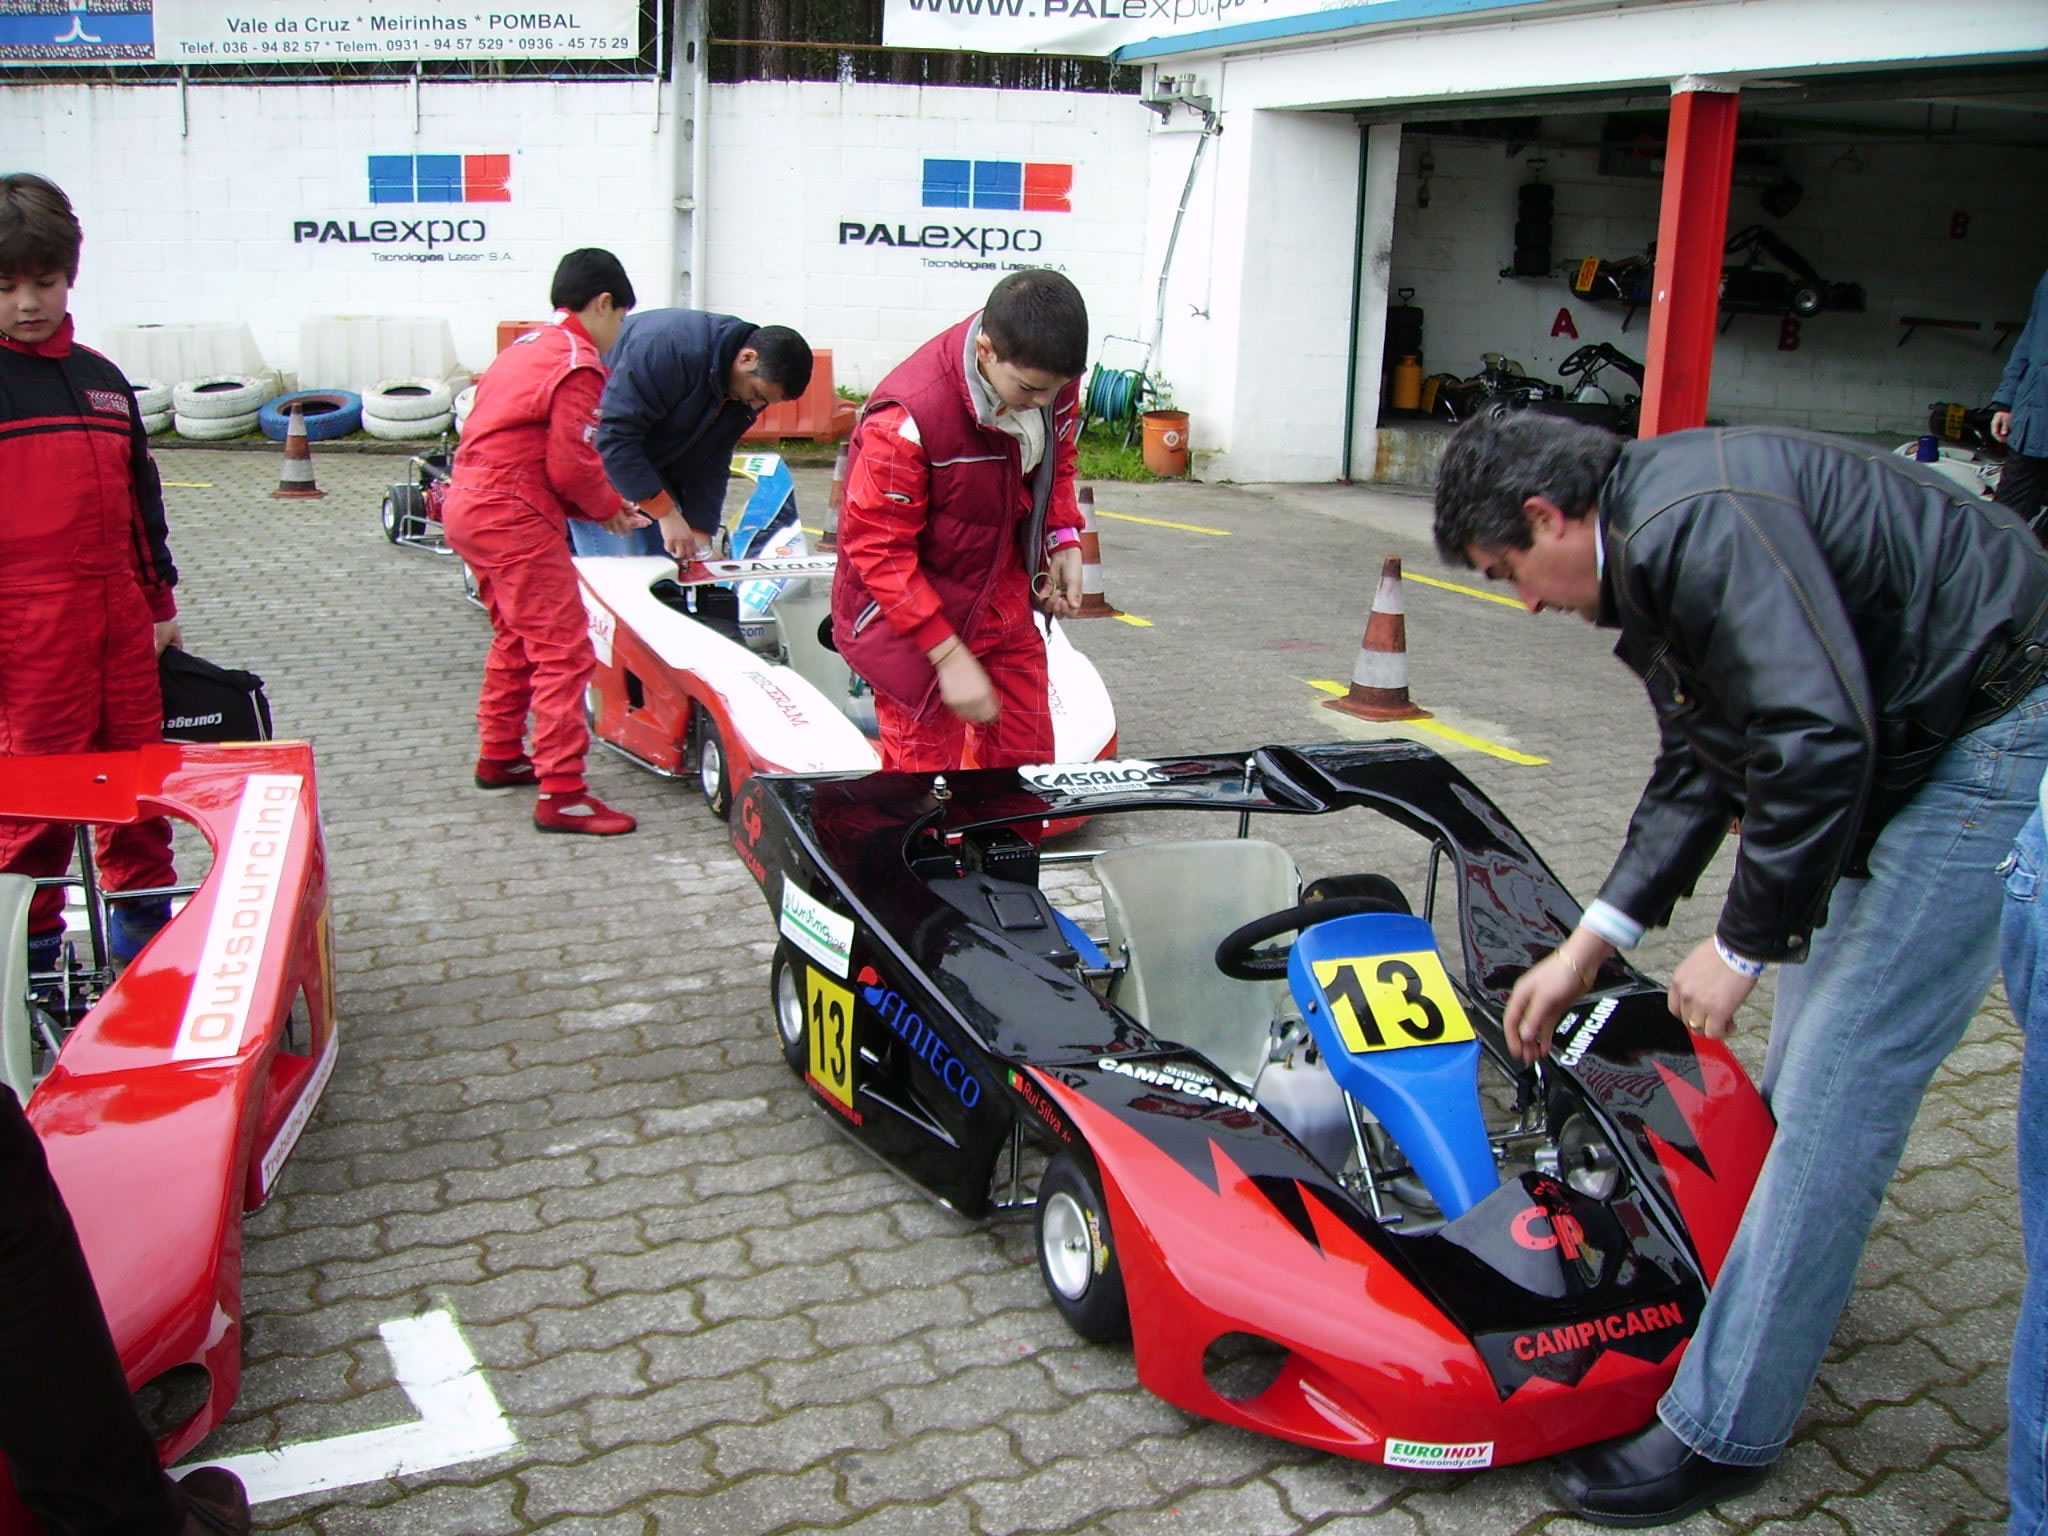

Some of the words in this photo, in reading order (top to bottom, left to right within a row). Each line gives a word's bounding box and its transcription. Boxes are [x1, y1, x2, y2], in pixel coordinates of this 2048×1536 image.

[226, 17, 268, 33] Vale
[275, 17, 298, 33] da
[305, 16, 350, 32] Cruz
[371, 15, 468, 32] Meirinhas
[489, 14, 581, 30] POMBAL
[180, 41, 218, 54] Telef.
[223, 42, 248, 53] 036
[262, 42, 279, 53] 94
[283, 42, 300, 52] 82
[304, 41, 320, 52] 57
[335, 41, 381, 52] Telem.
[387, 39, 418, 51] 0931
[434, 39, 451, 50] 94
[456, 39, 472, 49] 57
[478, 38, 503, 50] 529
[518, 38, 553, 49] 0936
[568, 38, 585, 49] 45
[590, 38, 607, 49] 75
[611, 38, 629, 49] 29
[293, 219, 486, 250] PALexpo
[839, 221, 1042, 257] PALexpo
[1951, 211, 1969, 239] B
[448, 252, 484, 262] Laser
[1551, 307, 1579, 339] A
[1778, 318, 1801, 351] B
[167, 712, 222, 729] Courage
[188, 785, 298, 1044] Outsourcing
[1322, 959, 1446, 1047] 13
[813, 988, 846, 1089] 13
[1559, 997, 1620, 1067] CAMPICARN
[878, 991, 981, 1109] FINIECO
[1098, 1057, 1259, 1114] CAMPICARN
[1022, 1079, 1039, 1104] Rui
[1037, 1097, 1062, 1135] Silva
[1513, 1301, 1684, 1361] CAMPICARN
[1389, 1456, 1487, 1468] www.euroindy.com
[1392, 1443, 1489, 1458] EUROINDY
